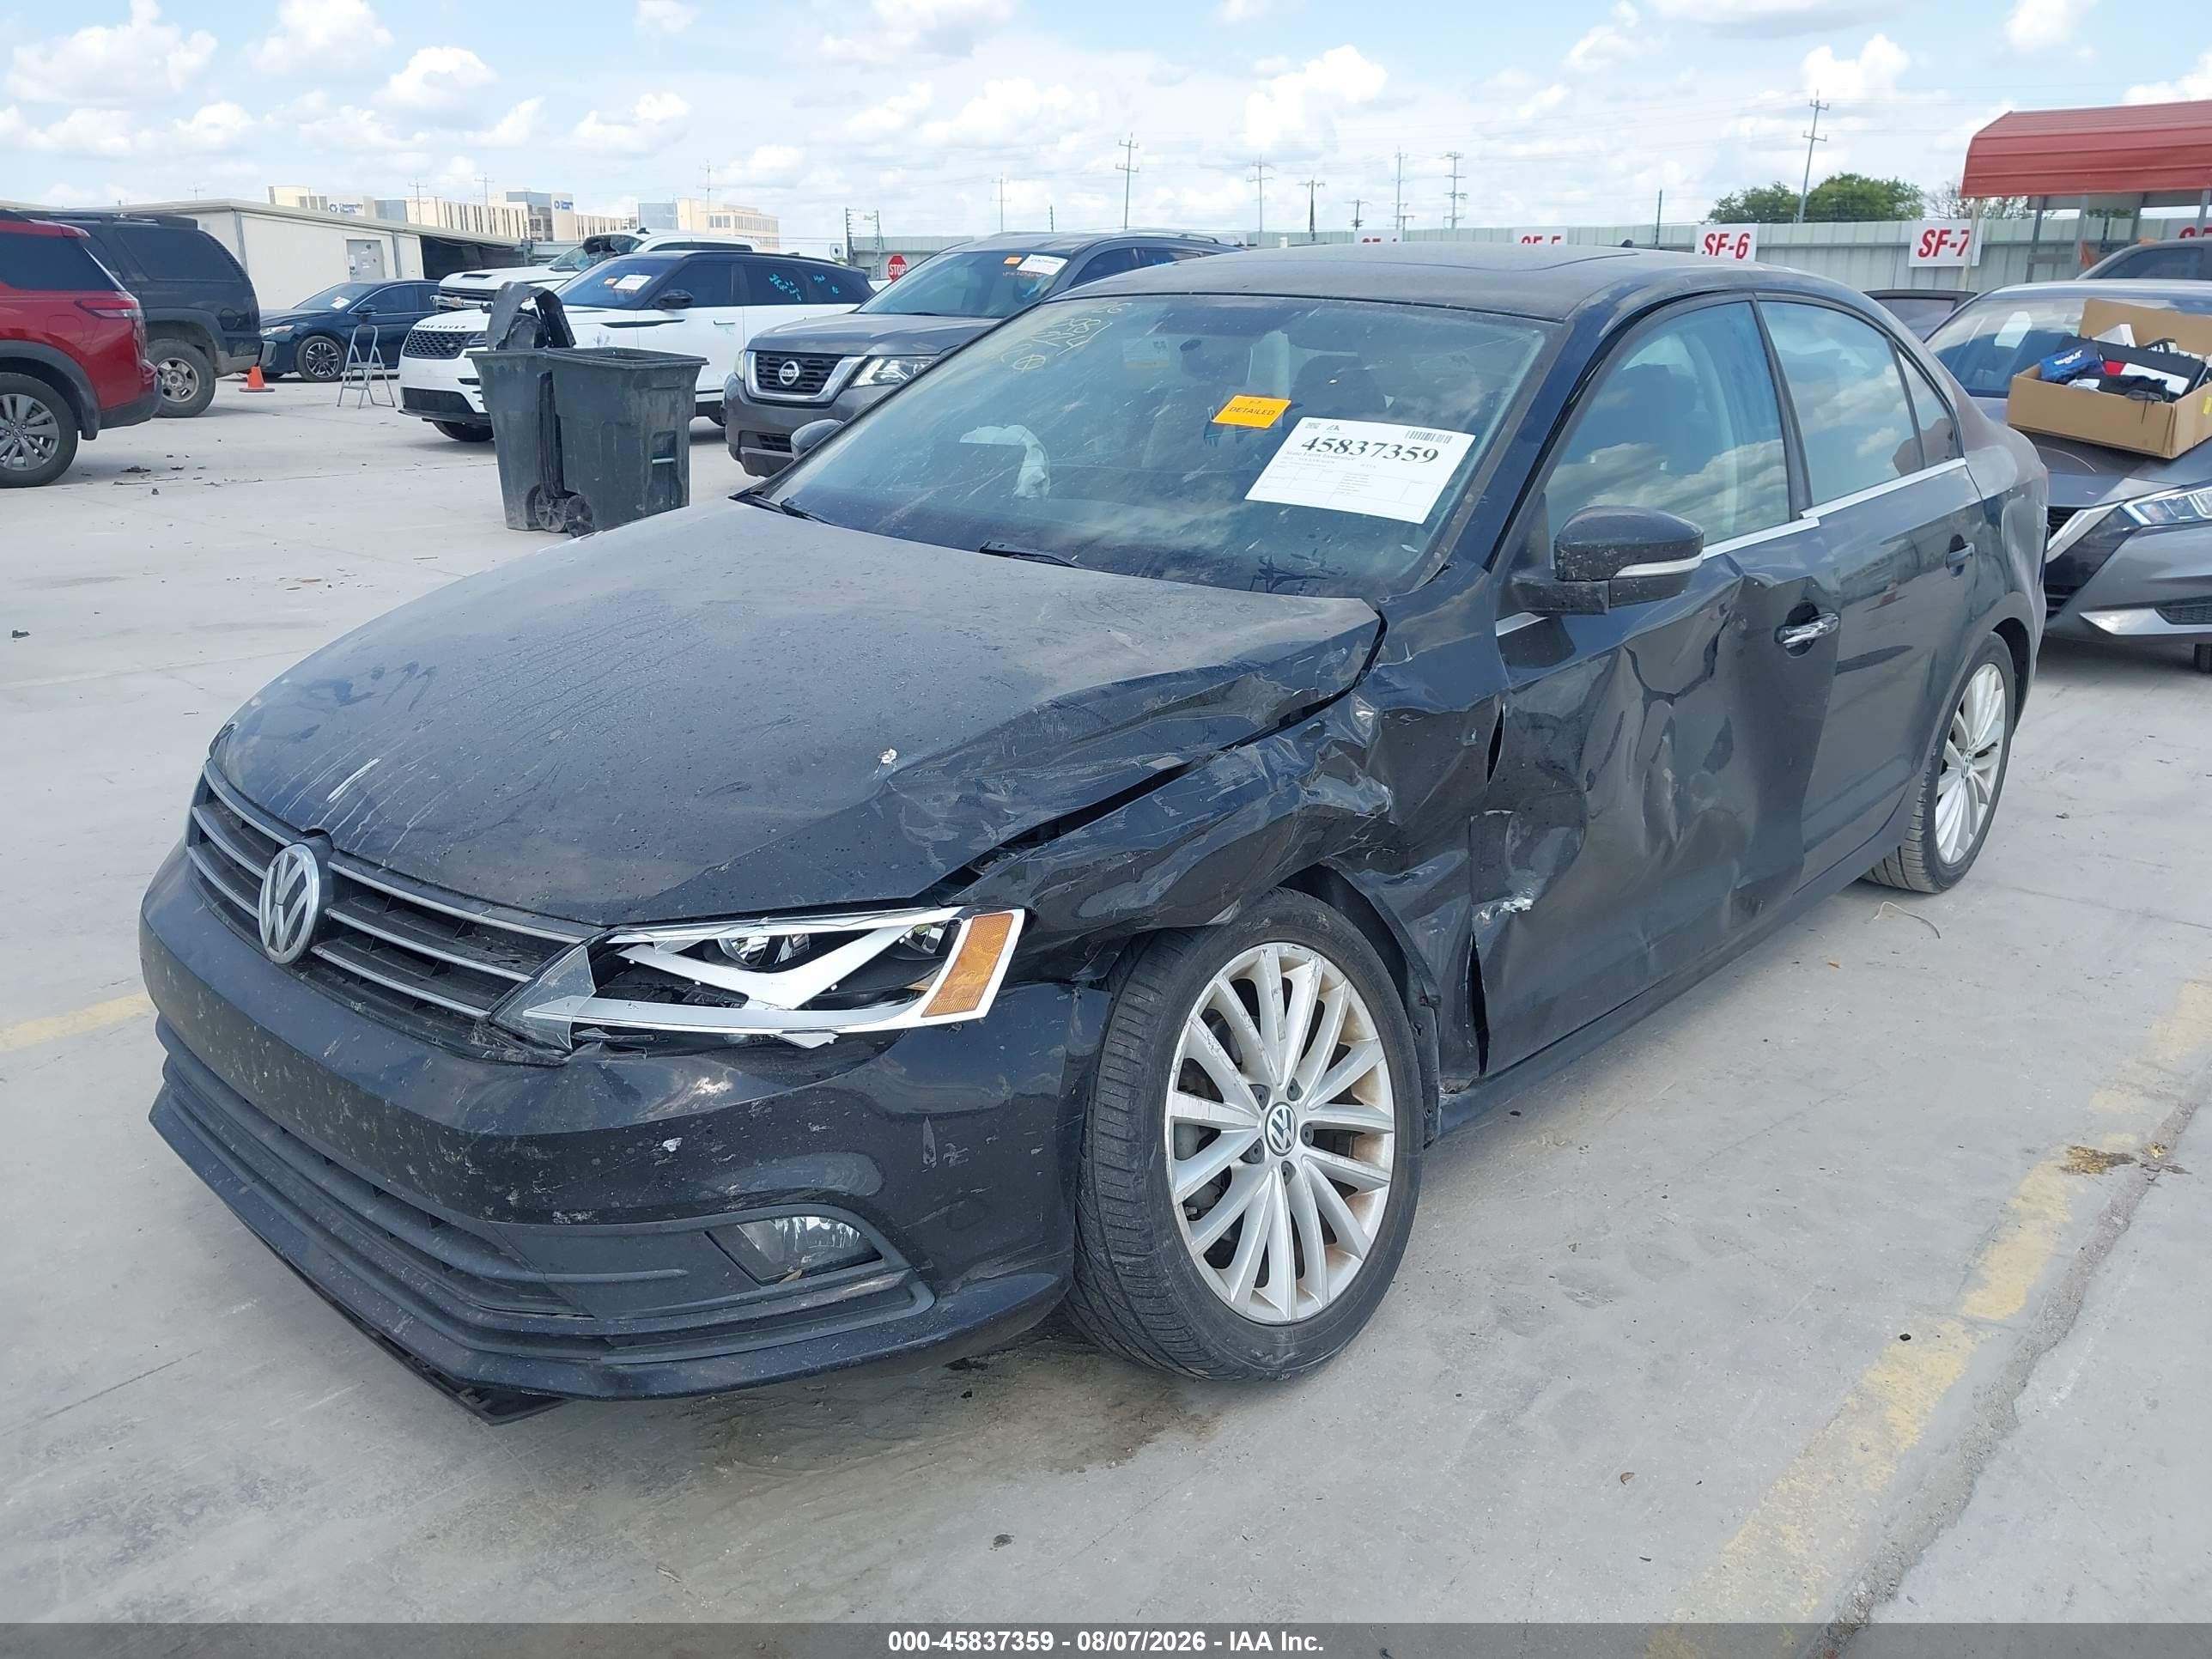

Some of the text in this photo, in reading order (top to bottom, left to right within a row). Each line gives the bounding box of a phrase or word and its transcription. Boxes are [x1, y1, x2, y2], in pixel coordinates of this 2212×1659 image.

[1702, 233, 1751, 259] SF-6
[1917, 229, 1971, 258] SF-7
[889, 264, 907, 276] STOP
[1229, 406, 1276, 416] DETAILED
[1301, 436, 1439, 464] 45837359
